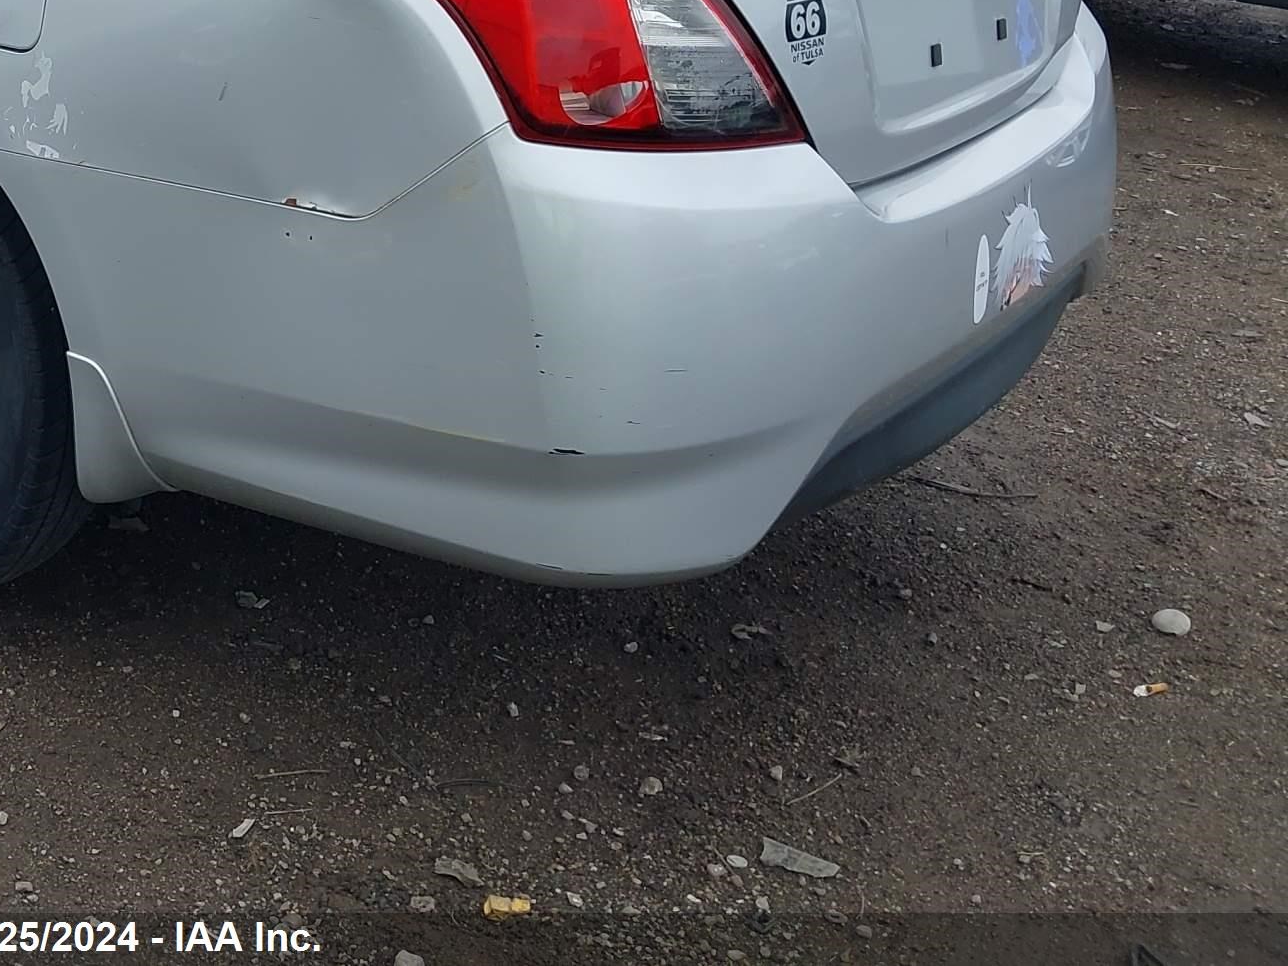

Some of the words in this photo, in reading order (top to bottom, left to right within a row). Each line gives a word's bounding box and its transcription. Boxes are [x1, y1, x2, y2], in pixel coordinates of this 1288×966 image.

[790, 0, 821, 38] 66
[790, 37, 825, 53] NISSAN
[792, 54, 801, 63] of
[800, 48, 824, 61] TULSA
